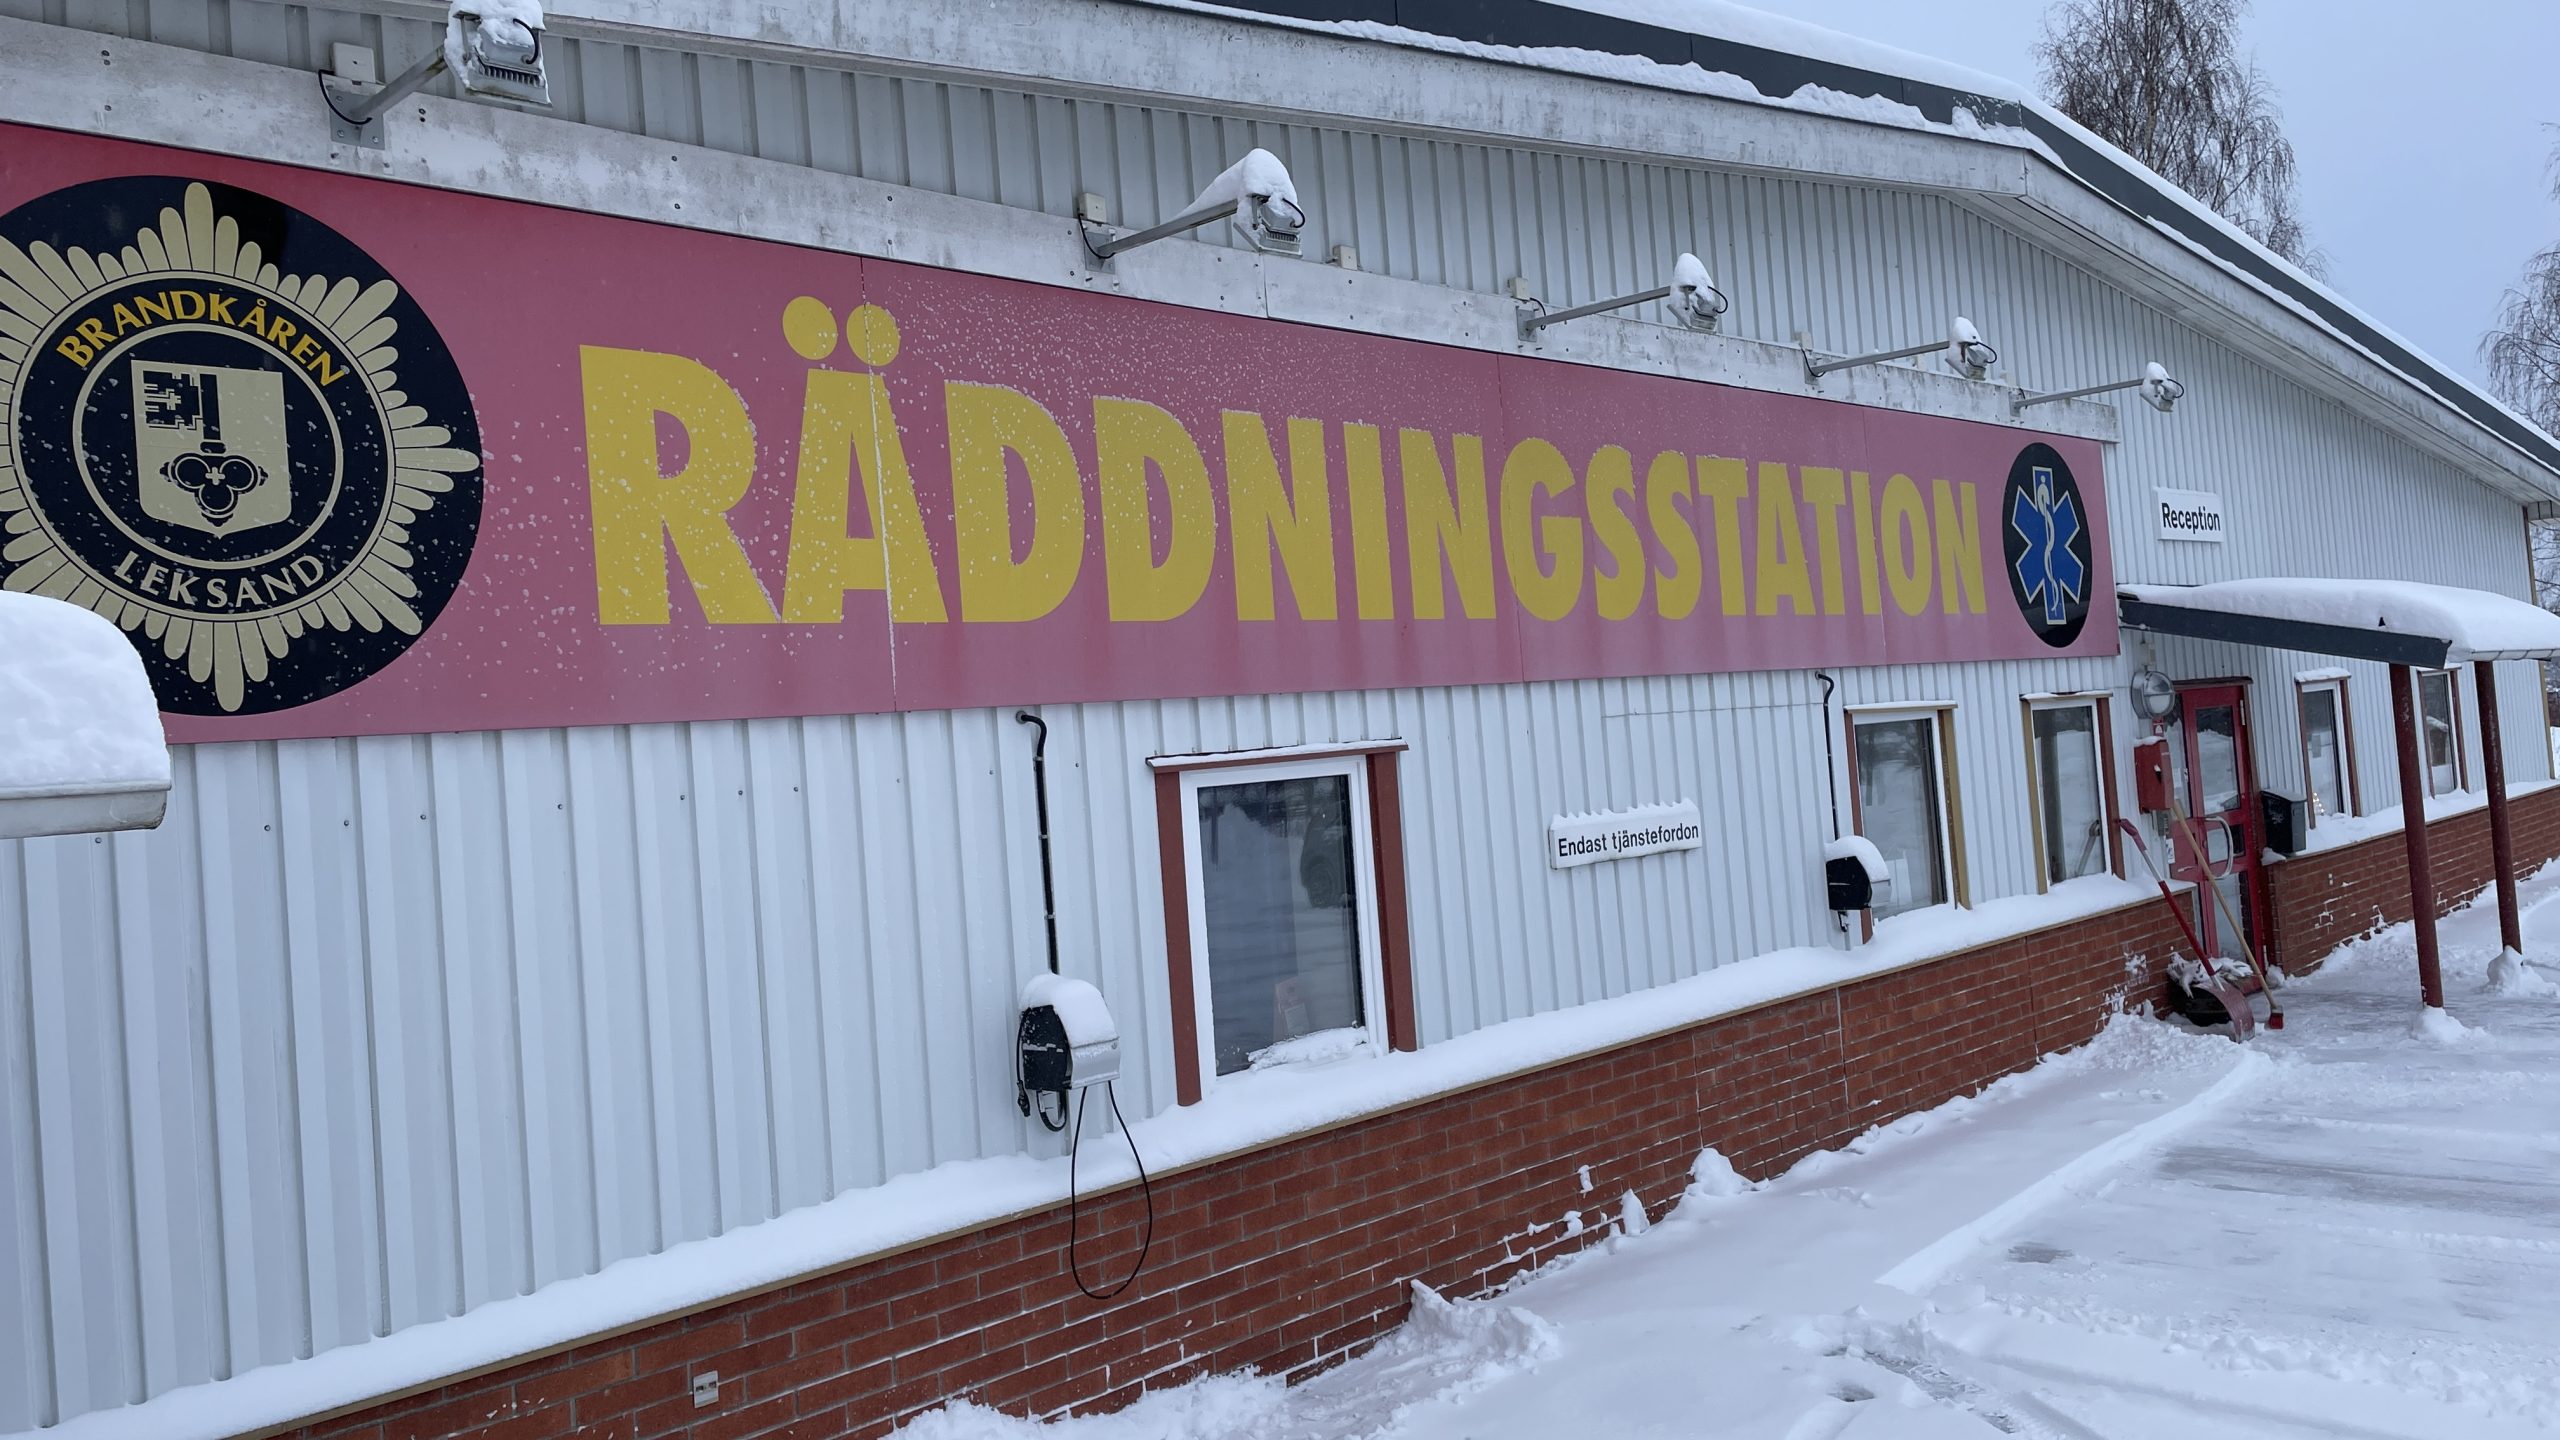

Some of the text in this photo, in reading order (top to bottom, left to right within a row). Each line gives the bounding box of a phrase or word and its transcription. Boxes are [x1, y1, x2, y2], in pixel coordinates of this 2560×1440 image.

[56, 290, 346, 387] BRANDKÅREN
[580, 296, 1987, 625] RÄDDNINGSSTATION
[2161, 502, 2221, 534] Reception
[114, 551, 325, 608] LEKSAND
[1558, 823, 1699, 857] Endast tjänstefordon
